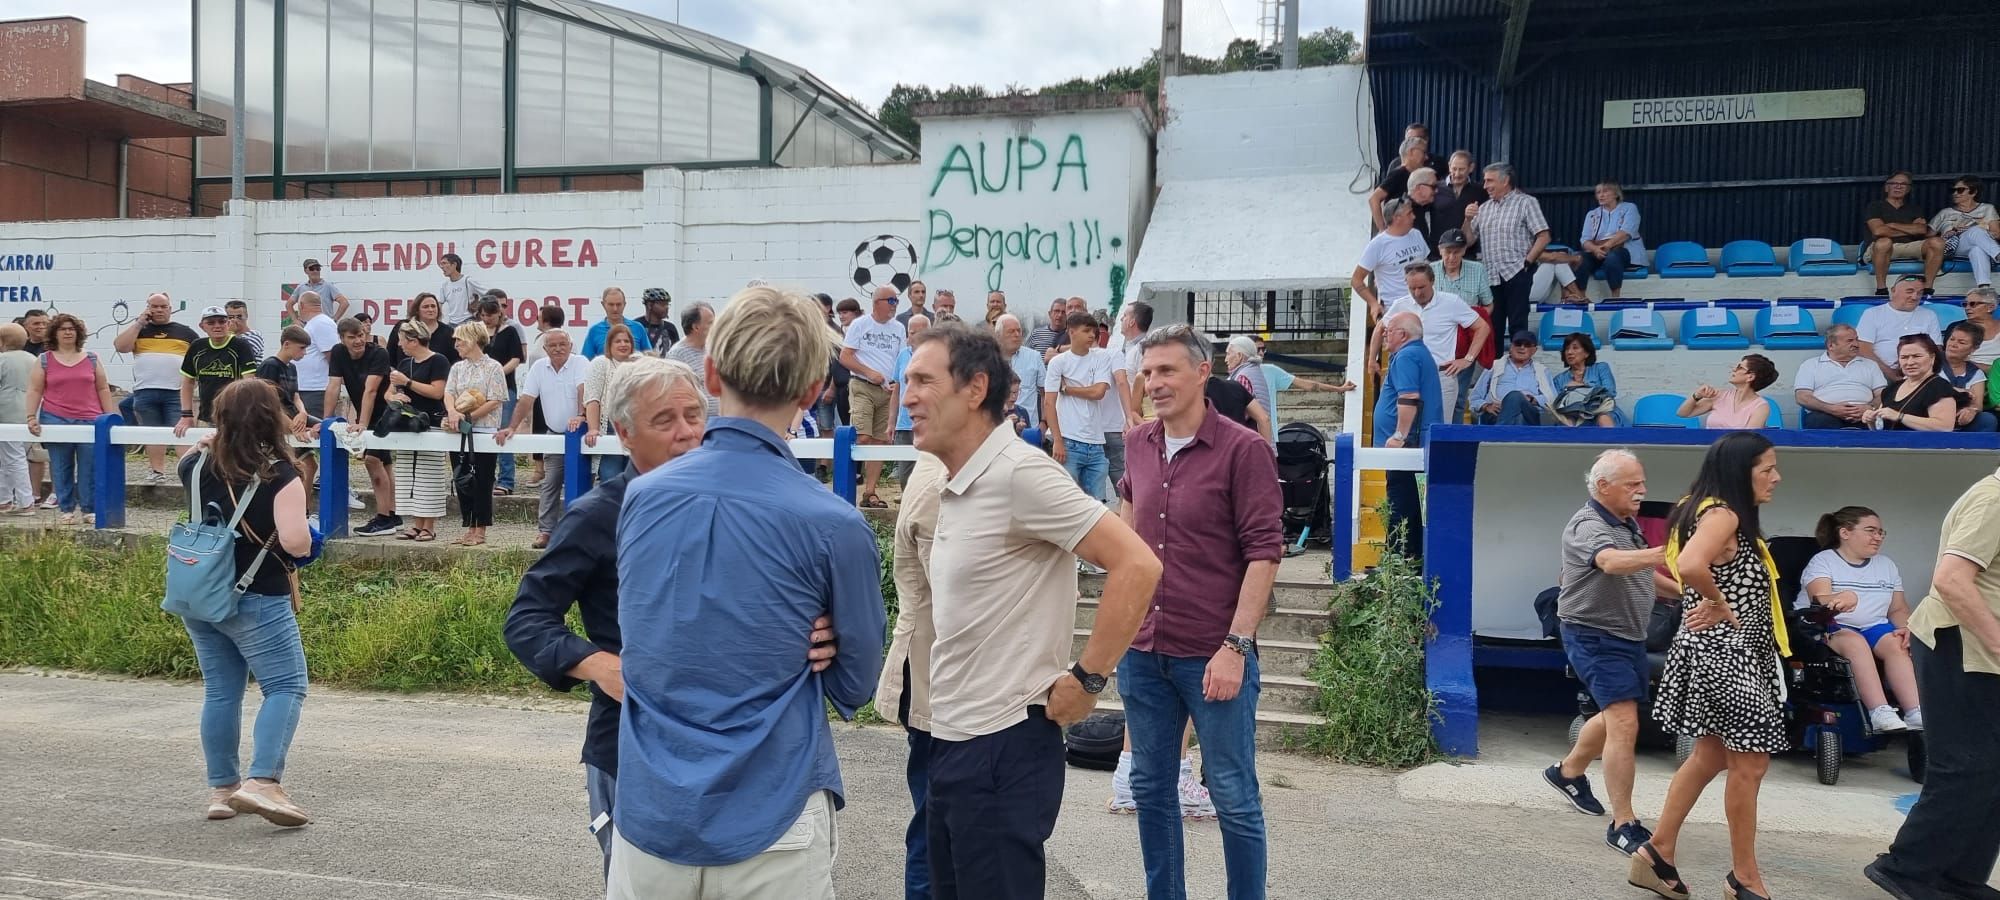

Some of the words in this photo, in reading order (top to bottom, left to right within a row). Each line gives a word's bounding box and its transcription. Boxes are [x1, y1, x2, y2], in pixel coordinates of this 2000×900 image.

[1631, 97, 1756, 124] ERRESERBATUA
[930, 133, 1088, 197] AUPA
[330, 241, 456, 272] ZAINDU
[475, 238, 599, 269] GUREA
[0, 286, 42, 302] TERA
